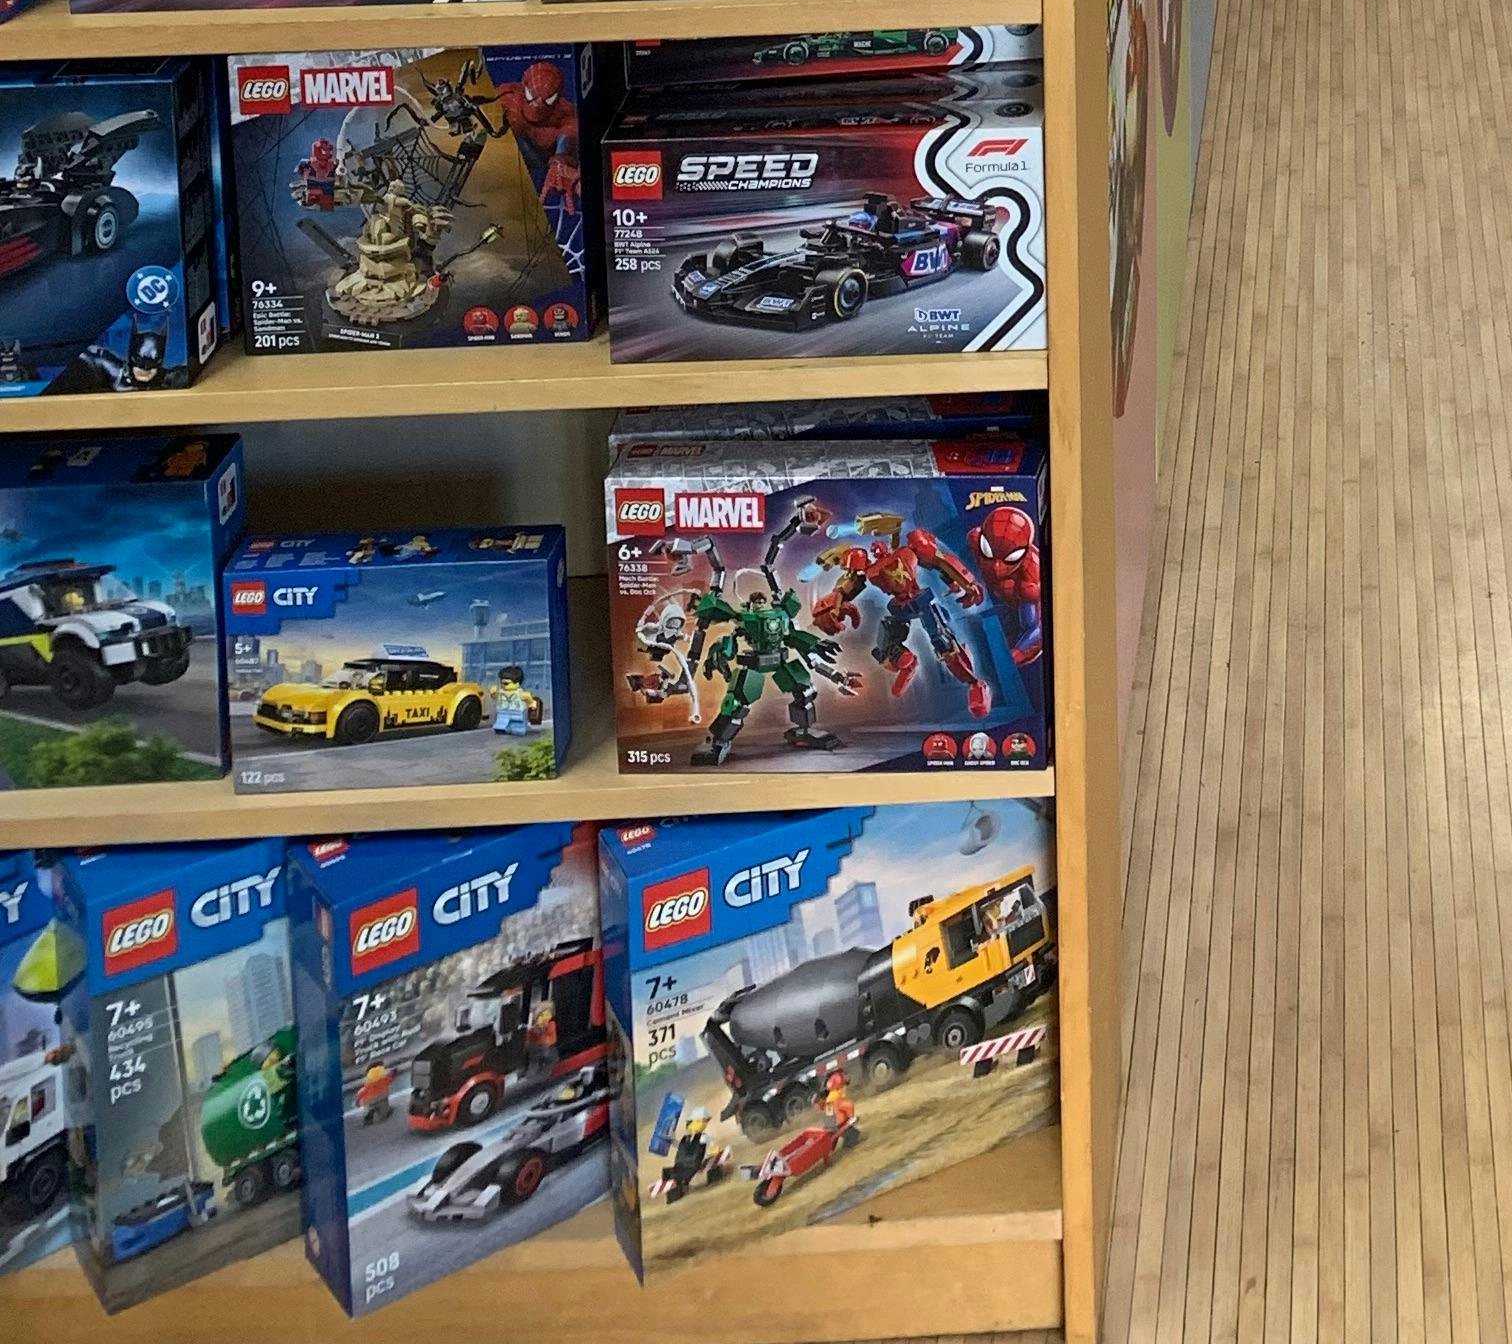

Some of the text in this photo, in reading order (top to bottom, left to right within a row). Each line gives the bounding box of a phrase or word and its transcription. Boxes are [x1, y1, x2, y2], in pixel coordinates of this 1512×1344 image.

[242, 80, 288, 100] LEGO
[305, 70, 392, 103] MARVEL
[613, 153, 819, 187] LEGO SPEED
[728, 179, 812, 190] CHAMPIONS
[613, 209, 647, 226] 10+
[614, 230, 643, 238] 77248
[615, 258, 661, 272] 258 pcs
[251, 280, 277, 298] 9+
[252, 300, 284, 308] 76334
[929, 309, 961, 322] BWT
[907, 324, 970, 332] ALPINE
[254, 335, 300, 350] 201 pcs
[617, 500, 664, 522] LEGO
[678, 497, 764, 529] MARVEL
[618, 544, 642, 561] 6+
[233, 589, 265, 605] LEGO
[273, 586, 319, 606] CITY
[234, 643, 253, 654] 5+
[405, 708, 430, 719] TAXI
[627, 750, 671, 766] 315 pcs
[241, 772, 285, 785] 122 pcs
[646, 848, 811, 932] LEGO CITY
[107, 866, 282, 958] LEGO CITY
[353, 862, 519, 956] LEGO CITY
[646, 976, 677, 1000] 7+
[105, 999, 141, 1026] 7+
[353, 993, 385, 1021] 7+
[647, 994, 688, 1016] 60478
[110, 1078, 142, 1105] pcs
[364, 1253, 400, 1283] 508
[365, 1276, 396, 1304] pcs
